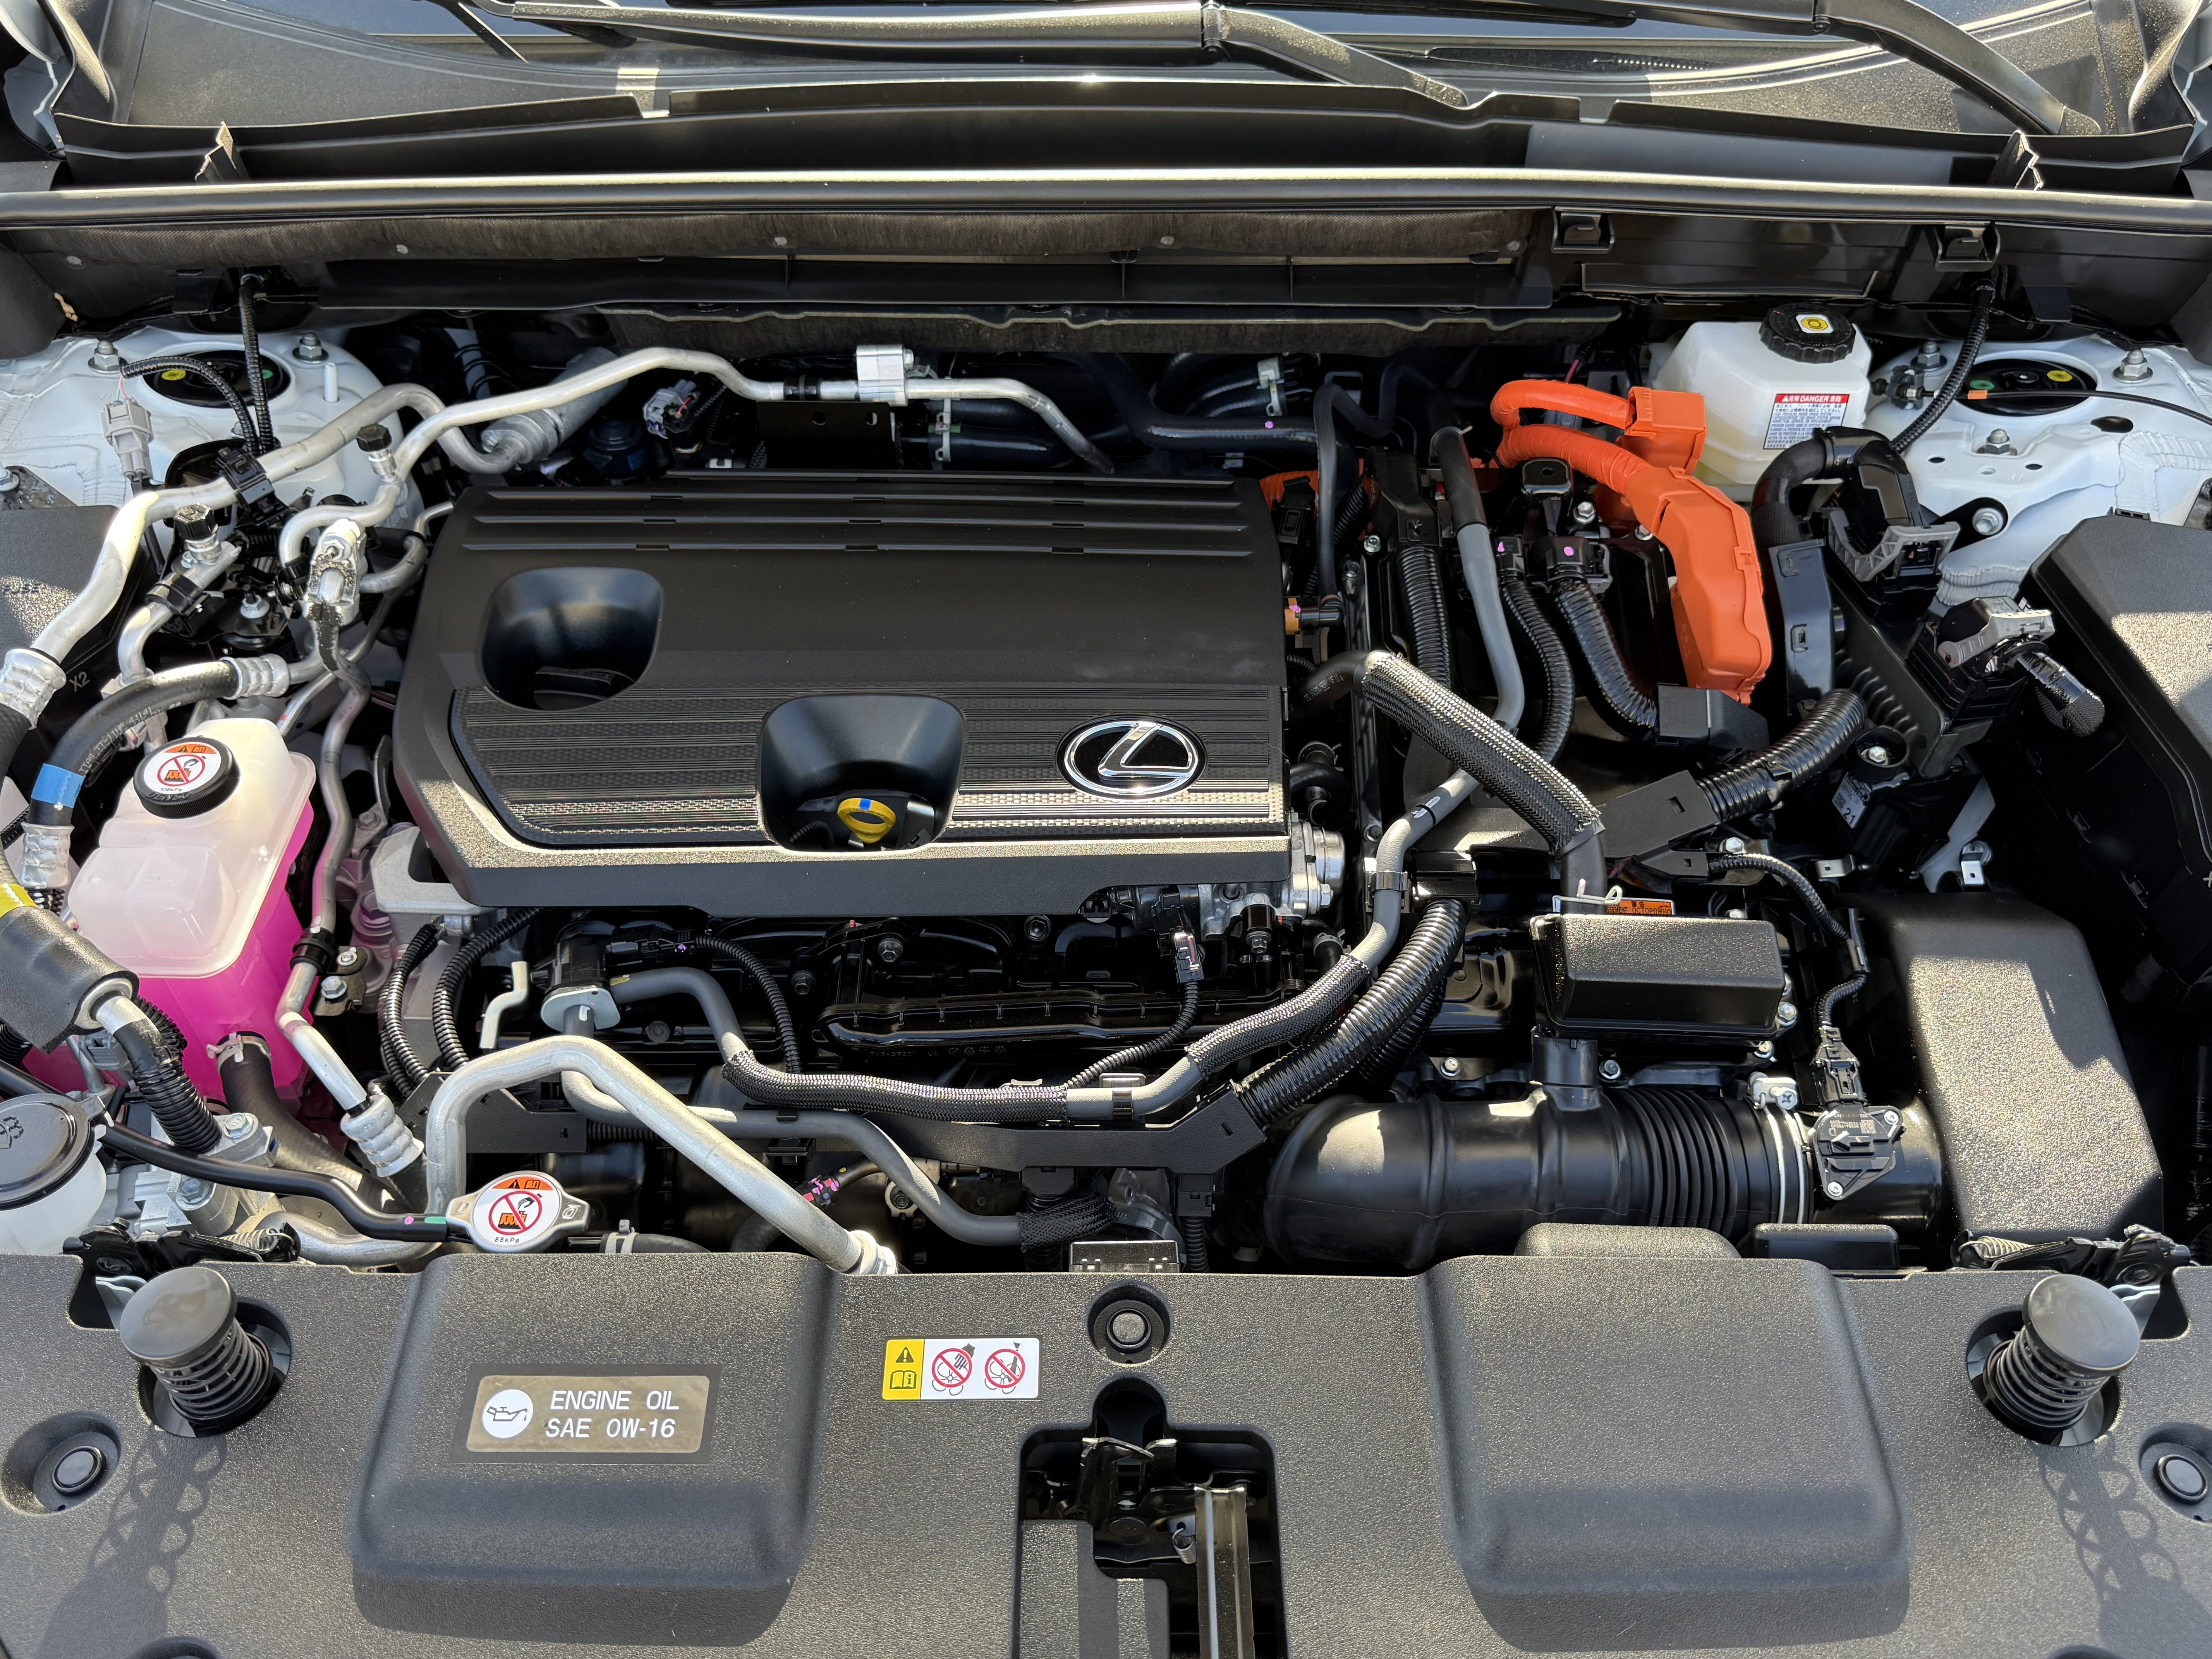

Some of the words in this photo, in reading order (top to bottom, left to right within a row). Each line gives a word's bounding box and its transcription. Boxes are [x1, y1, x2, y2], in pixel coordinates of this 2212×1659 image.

[69, 671, 90, 692] X2
[145, 791, 192, 801] DENSO
[1843, 807, 1856, 825] 21
[550, 1390, 632, 1410] ENGINE
[646, 1390, 680, 1410] OIL
[545, 1418, 592, 1438] SAE
[606, 1418, 676, 1438] 0W-16
